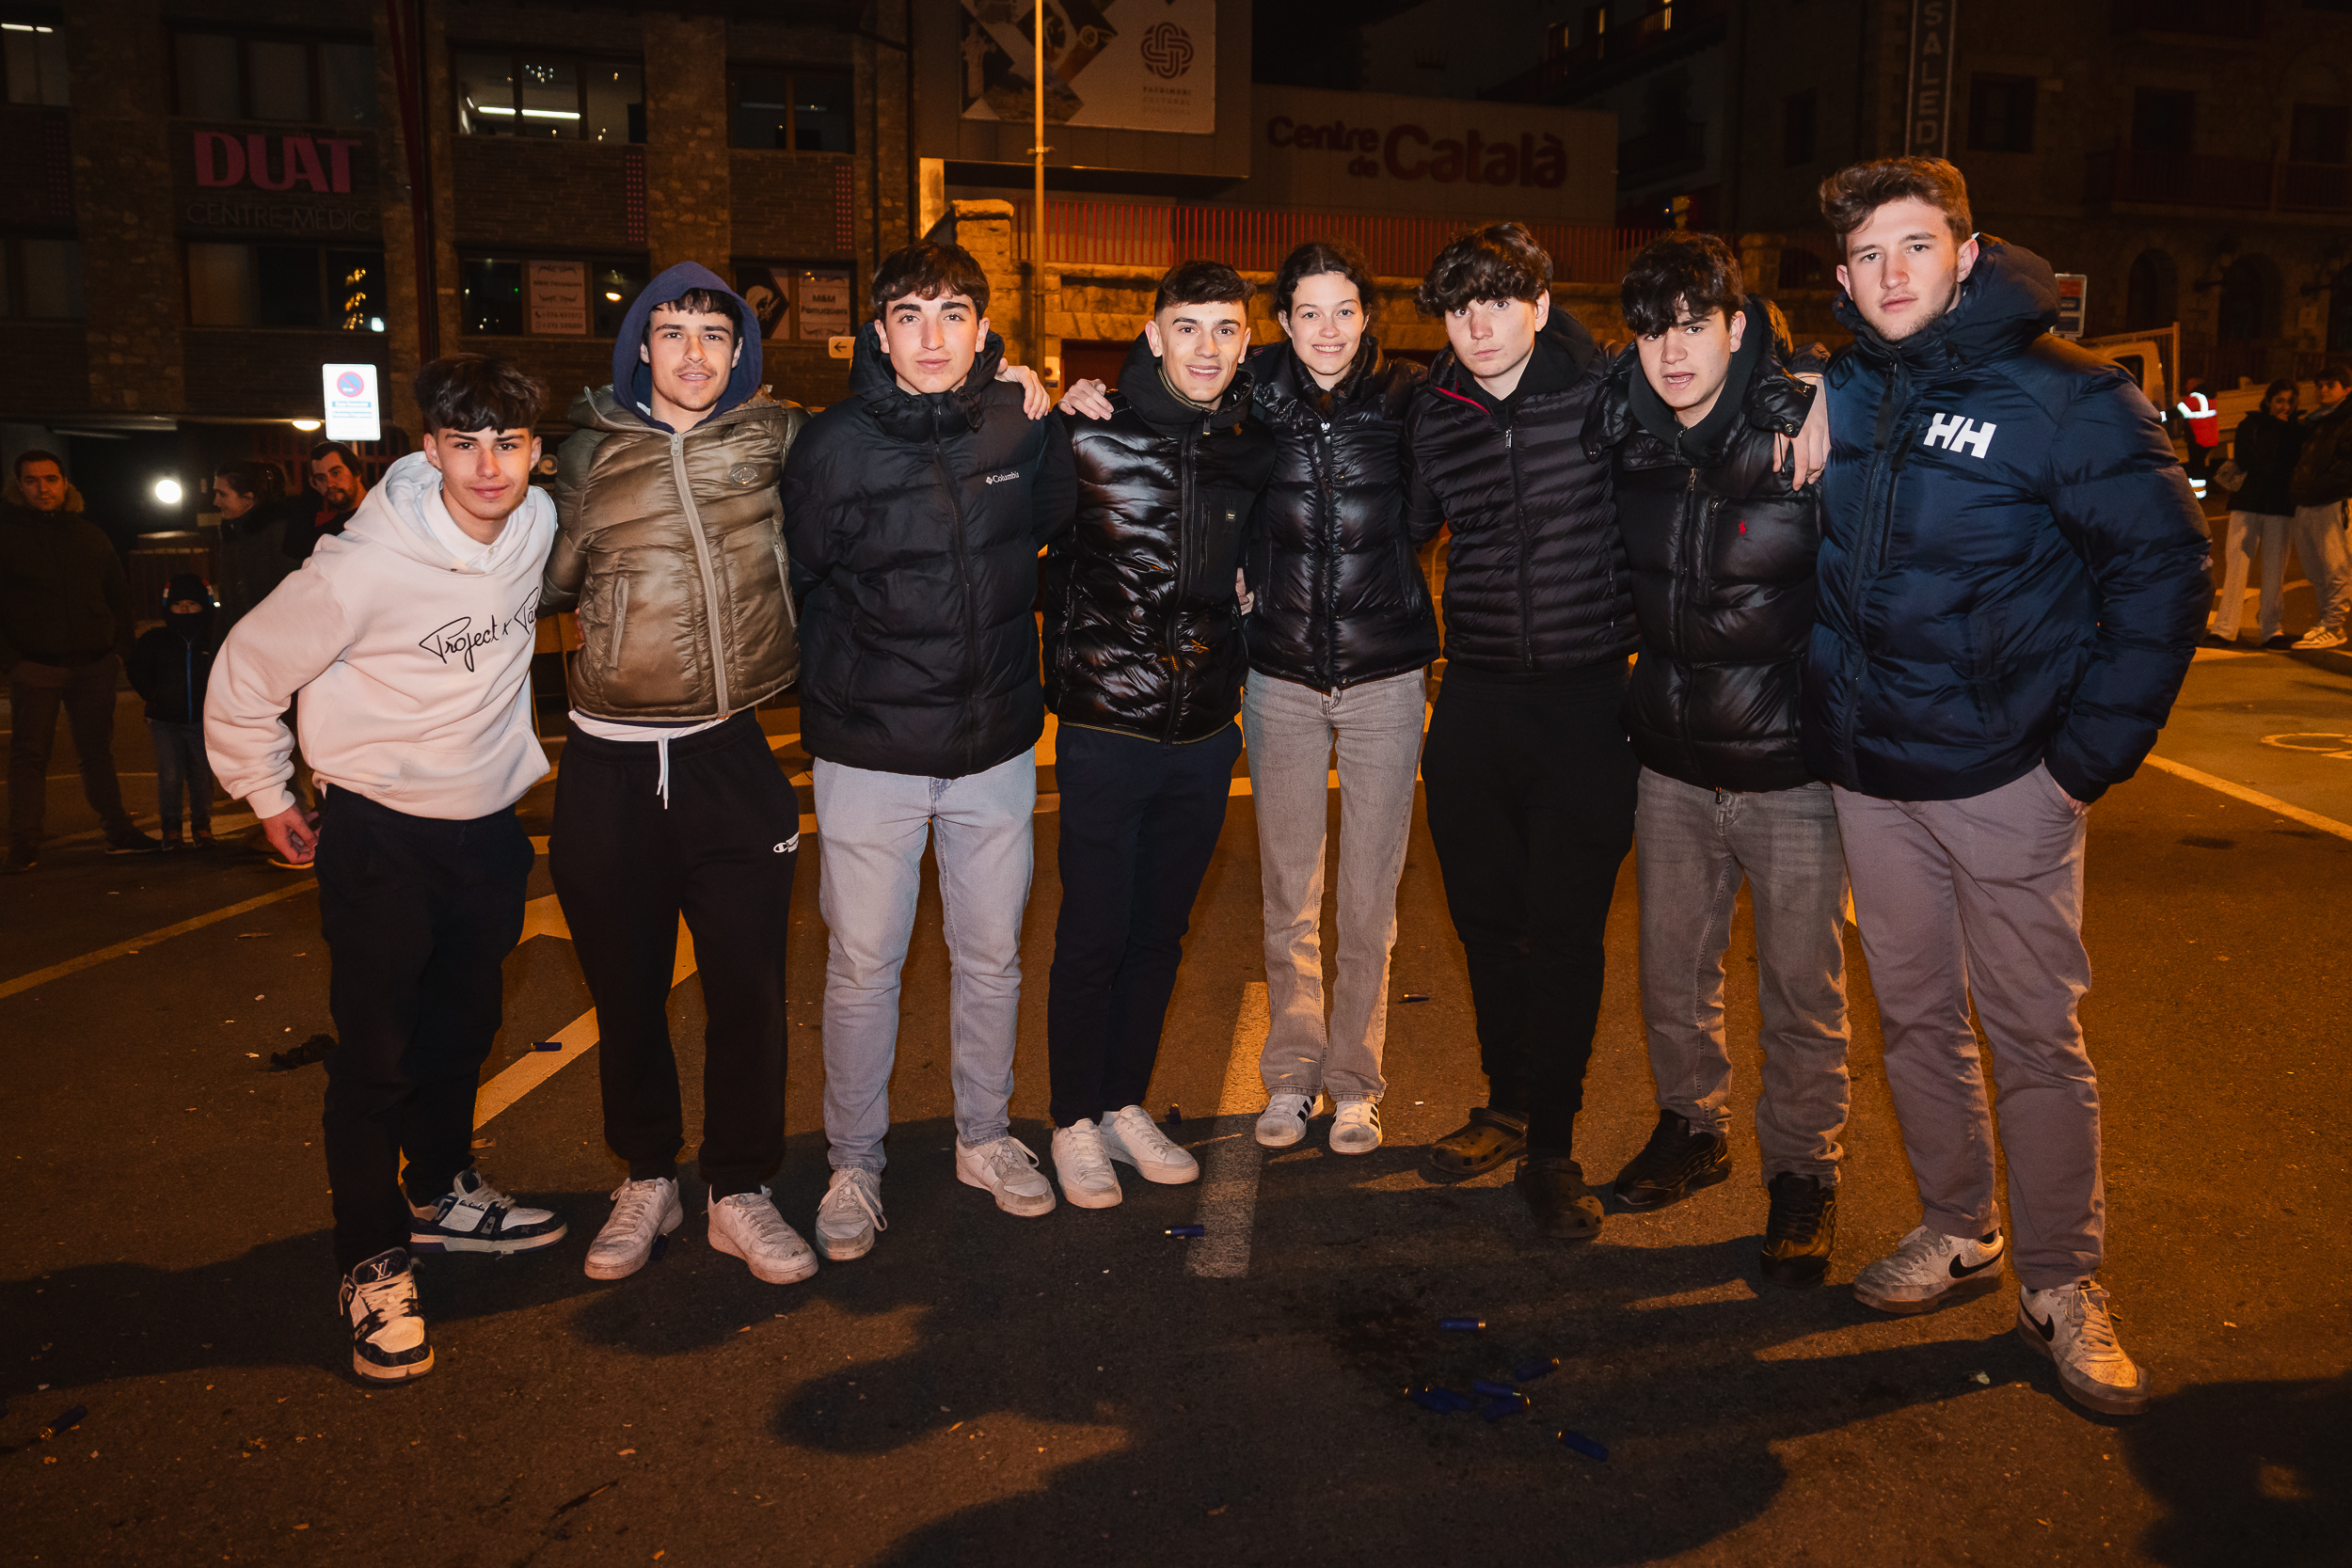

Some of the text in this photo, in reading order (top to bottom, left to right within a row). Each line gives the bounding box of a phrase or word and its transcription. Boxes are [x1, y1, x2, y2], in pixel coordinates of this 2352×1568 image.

[1915, 1, 1944, 158] SALED
[1267, 116, 1567, 188] Centre Català
[1348, 155, 1379, 178] de
[187, 203, 283, 228] CENTRE
[812, 294, 836, 303] M&M
[1923, 412, 1997, 459] HH
[419, 616, 500, 673] Project
